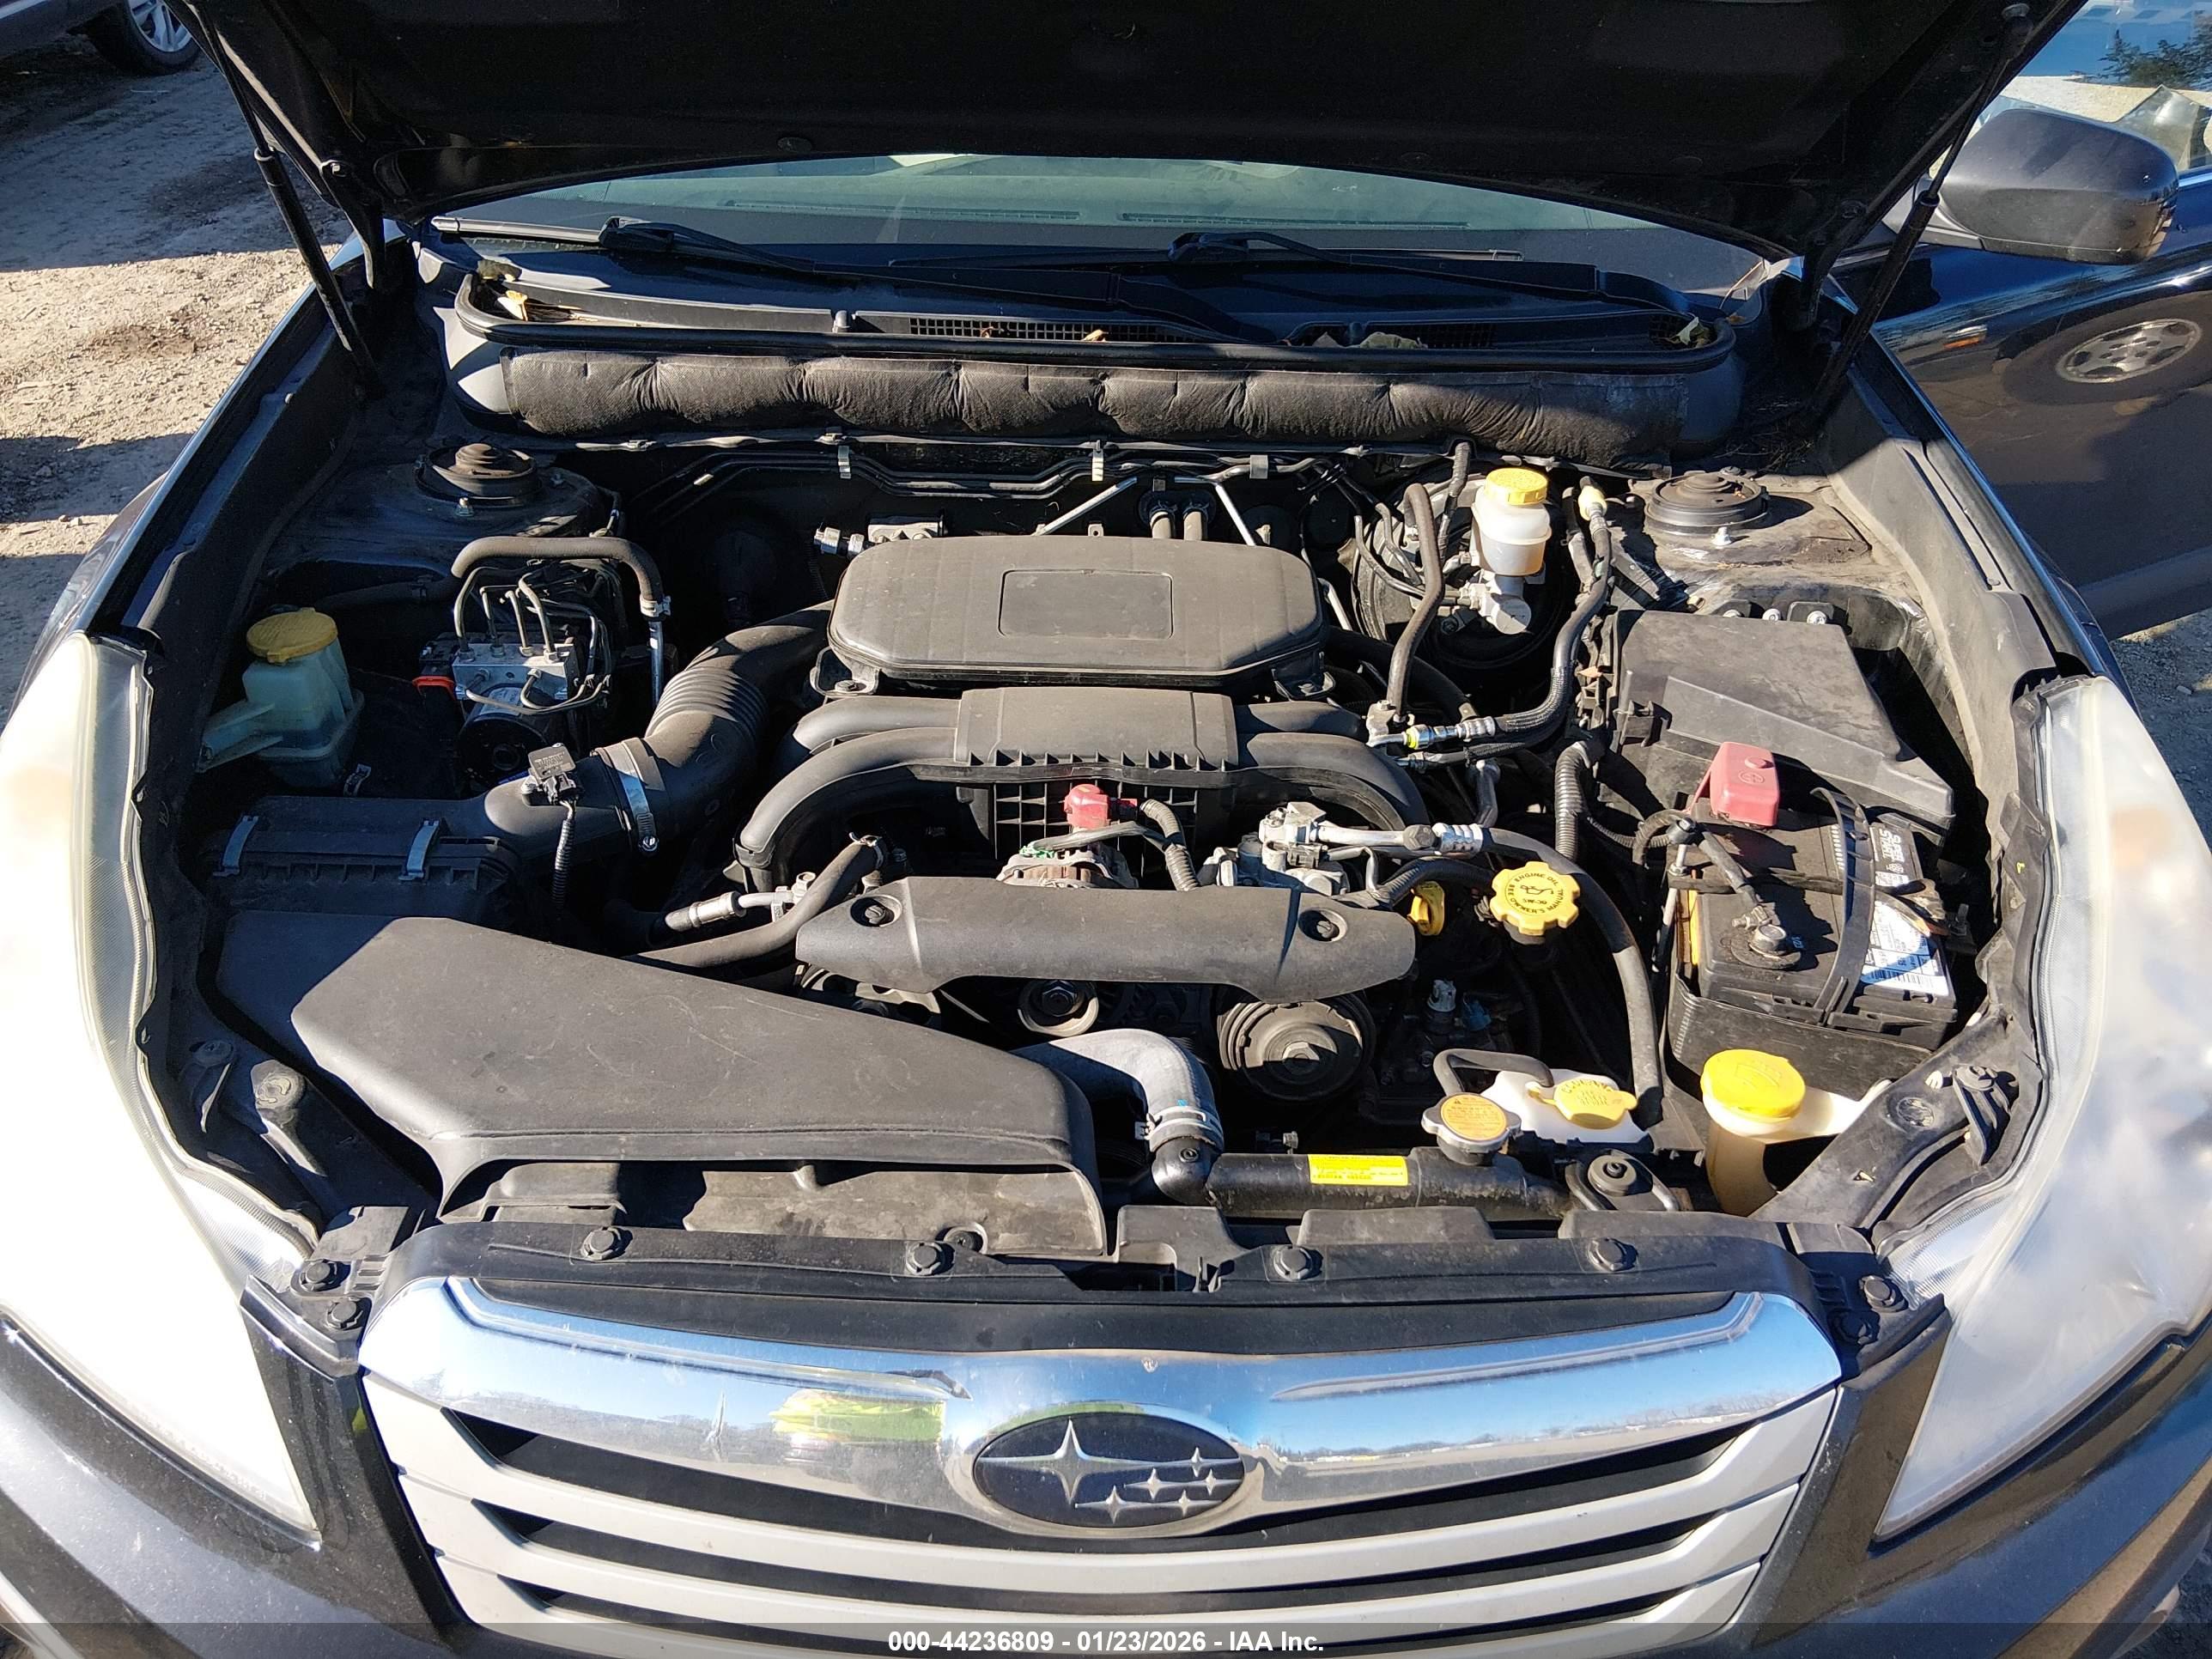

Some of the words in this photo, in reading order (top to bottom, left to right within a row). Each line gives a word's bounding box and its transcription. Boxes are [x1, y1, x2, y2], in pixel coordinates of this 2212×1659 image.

[1879, 829, 1893, 858] START
[1515, 872, 1546, 882] ENGINE
[1547, 876, 1559, 886] OIL
[1510, 897, 1545, 914] OWNER'S
[1547, 888, 1564, 911] MANUAL
